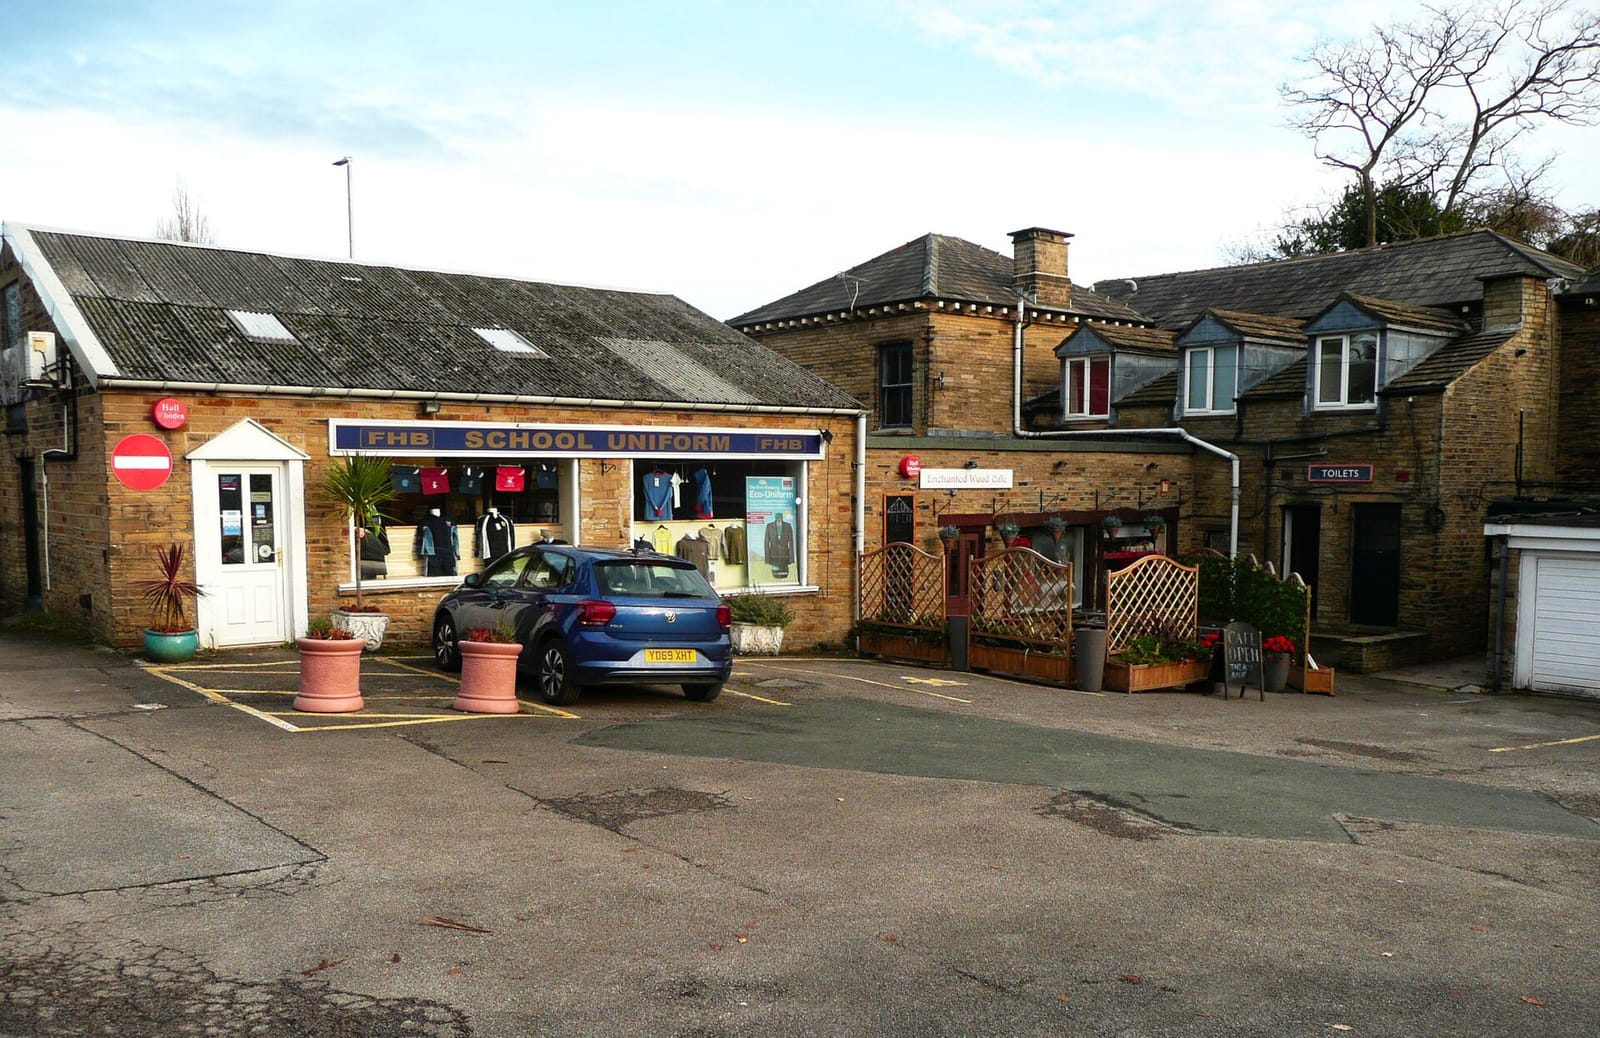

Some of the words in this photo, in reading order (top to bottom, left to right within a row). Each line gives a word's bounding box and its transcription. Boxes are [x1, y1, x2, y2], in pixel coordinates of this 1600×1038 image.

[367, 431, 431, 446] FHB
[464, 431, 593, 450] SCHOOL
[607, 433, 731, 451] UNIFORM
[760, 437, 804, 450] FHB
[927, 473, 968, 484] Enchanted
[969, 474, 990, 483] Wood
[1321, 469, 1360, 478] TOILETS
[749, 490, 794, 499] Eco-Uniform
[649, 650, 674, 660] YD69
[675, 650, 693, 660] XHT
[1228, 647, 1260, 663] OPEN
